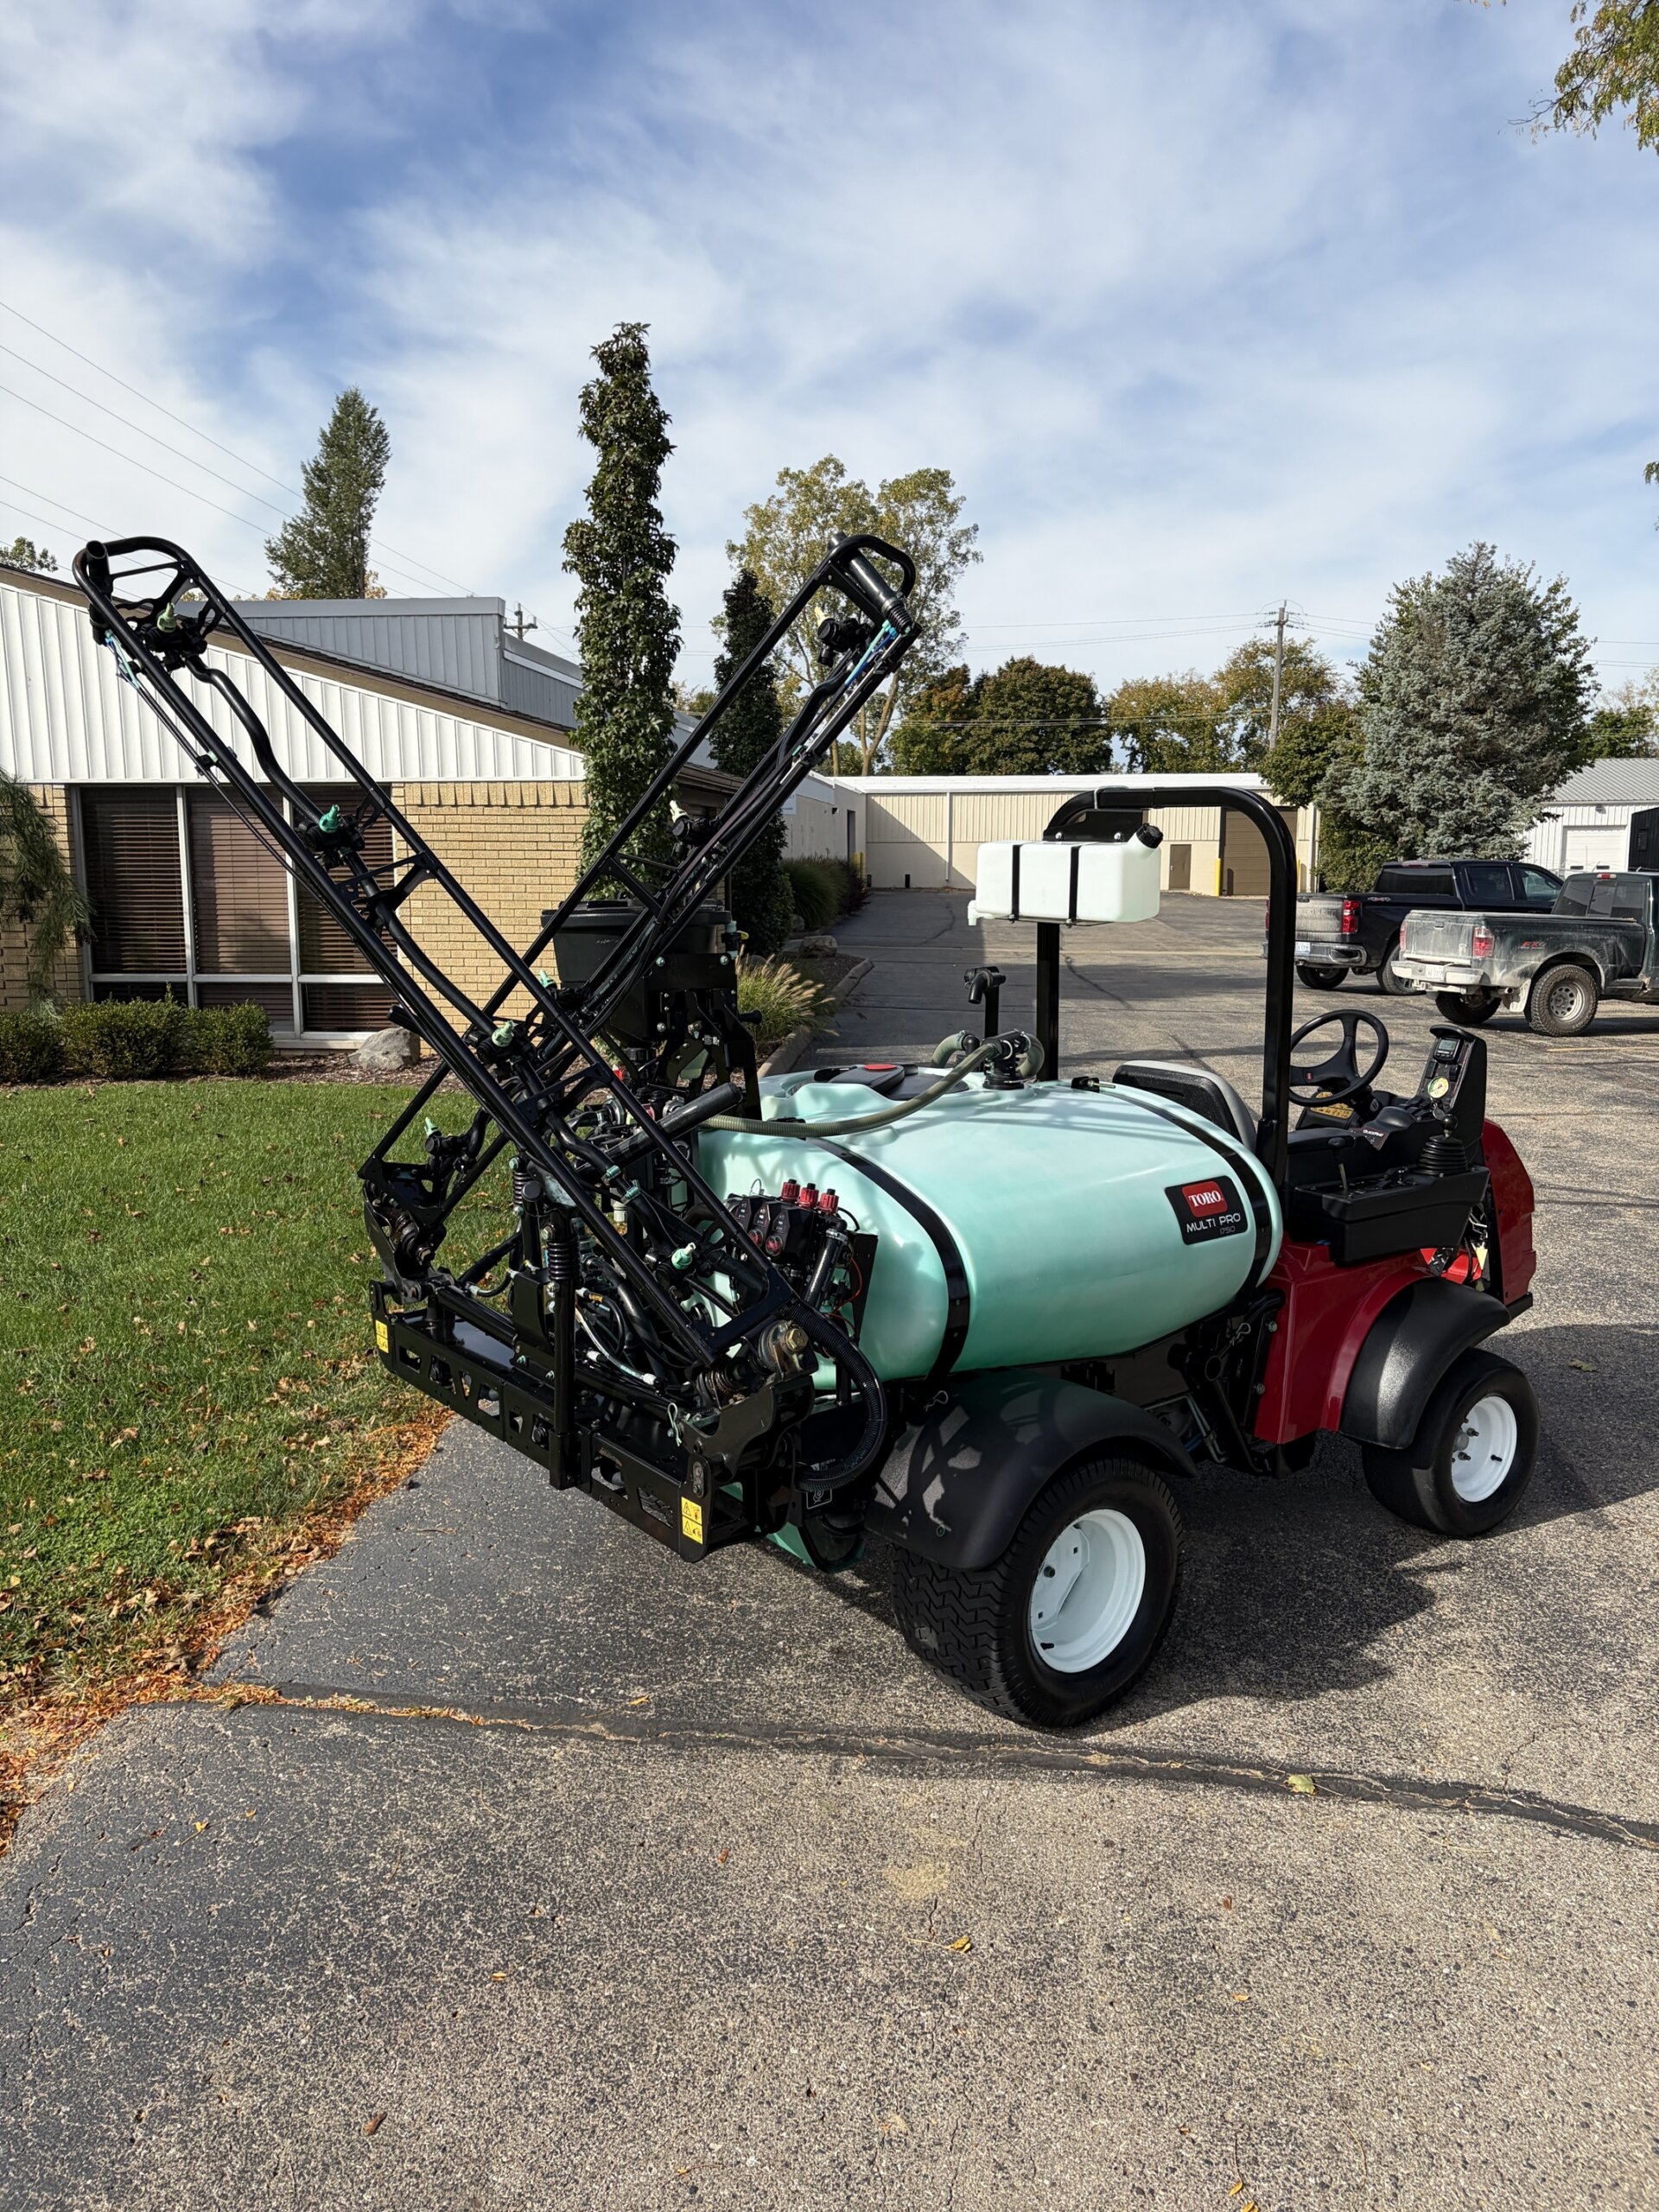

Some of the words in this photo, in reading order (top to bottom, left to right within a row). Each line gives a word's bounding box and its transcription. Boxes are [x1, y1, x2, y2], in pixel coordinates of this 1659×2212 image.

[1188, 1191, 1222, 1207] TORO
[1186, 1217, 1217, 1233] MULTI
[1219, 1213, 1241, 1225] PRO
